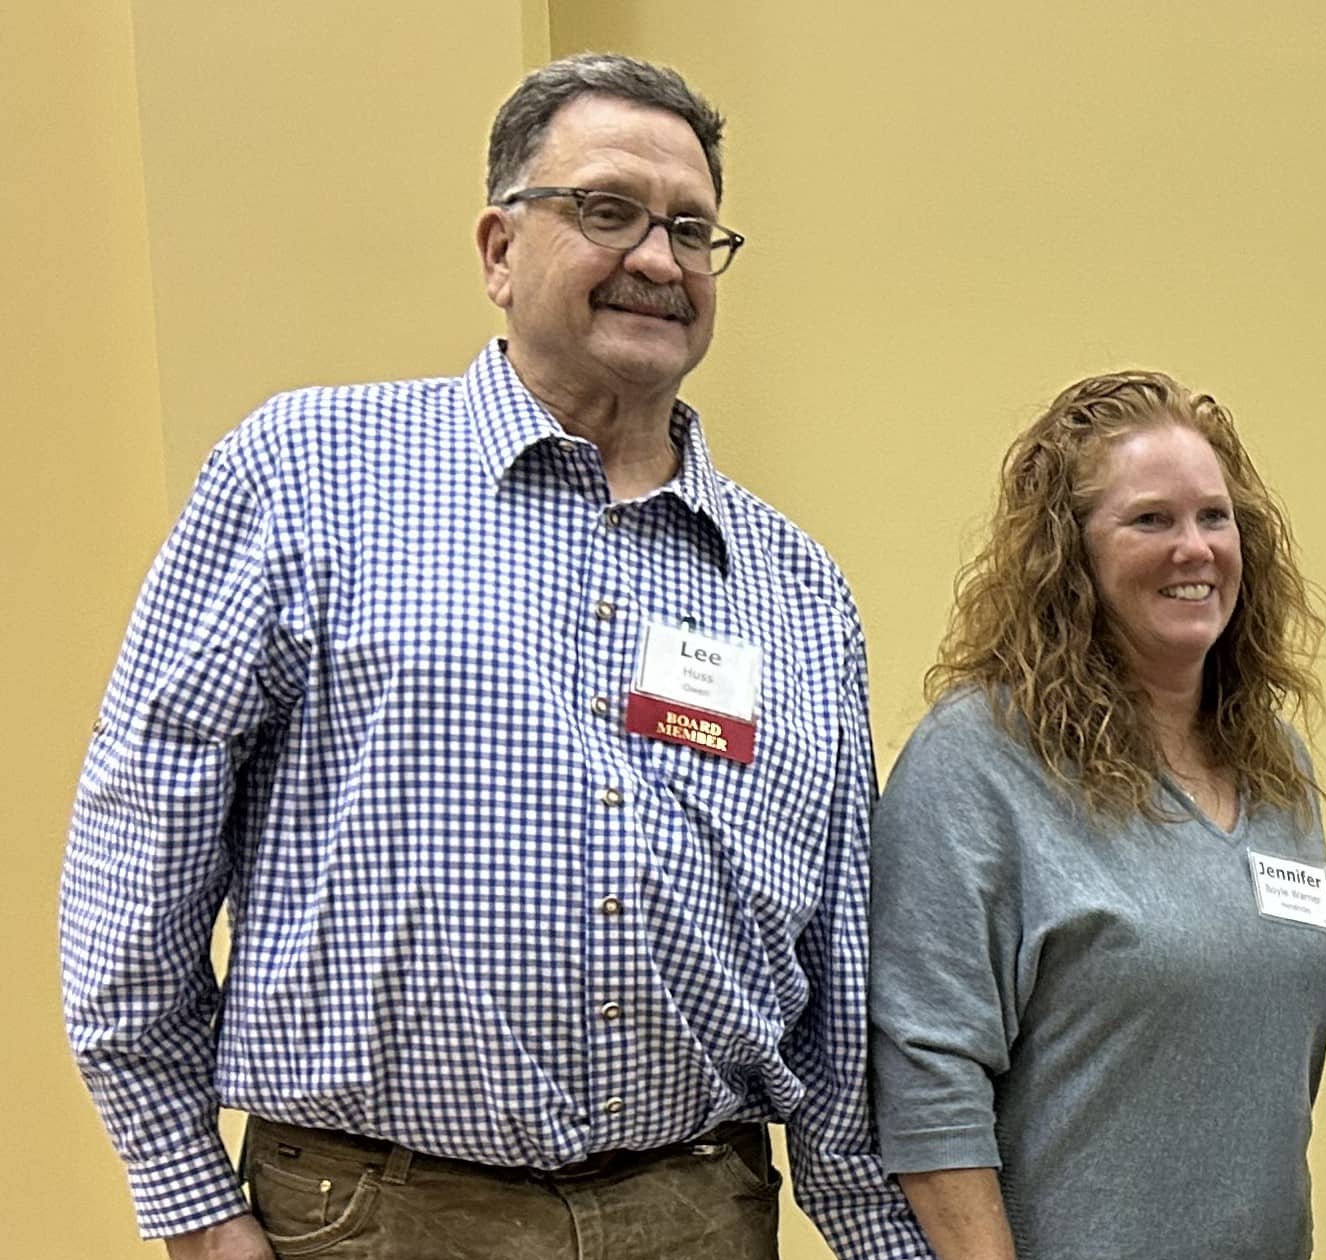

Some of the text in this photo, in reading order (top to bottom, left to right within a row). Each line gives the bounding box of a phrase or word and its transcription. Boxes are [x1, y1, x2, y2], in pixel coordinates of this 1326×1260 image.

[680, 641, 722, 666] Lee
[683, 667, 714, 684] Huss
[656, 722, 728, 752] MEMBER
[666, 711, 722, 737] BOARD
[1259, 861, 1322, 888] Jennifer
